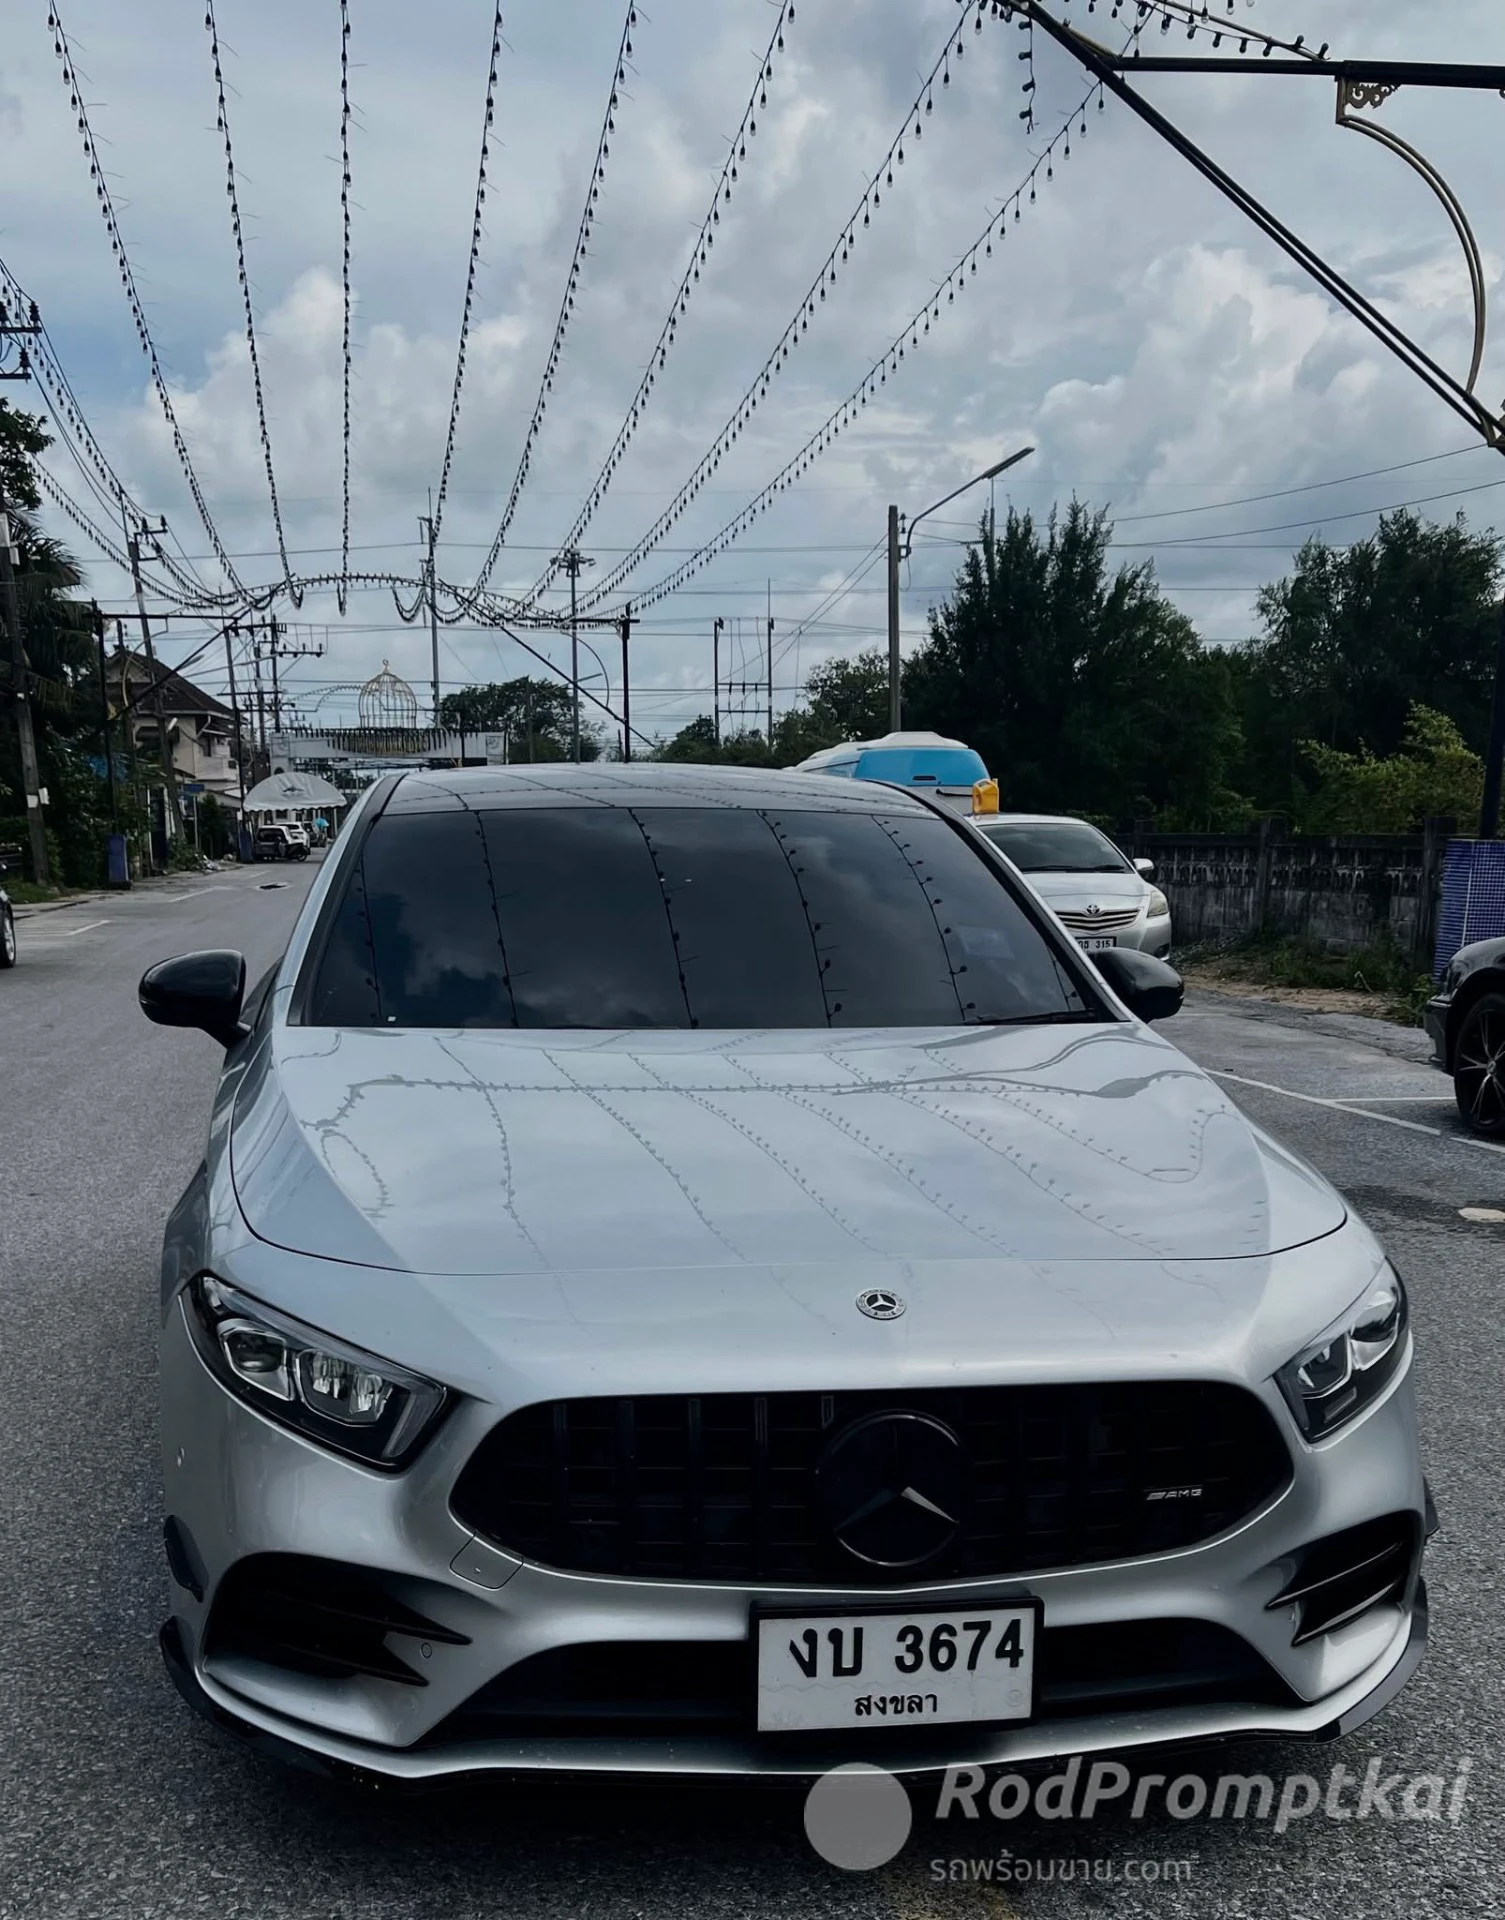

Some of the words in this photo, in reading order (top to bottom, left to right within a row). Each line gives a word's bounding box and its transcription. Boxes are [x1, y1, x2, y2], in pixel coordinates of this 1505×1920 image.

[1095, 940, 1110, 949] 315
[1163, 1488, 1203, 1499] AMG
[788, 1626, 864, 1678] งบ
[894, 1618, 1025, 1674] 3674
[854, 1693, 938, 1717] สงขลา
